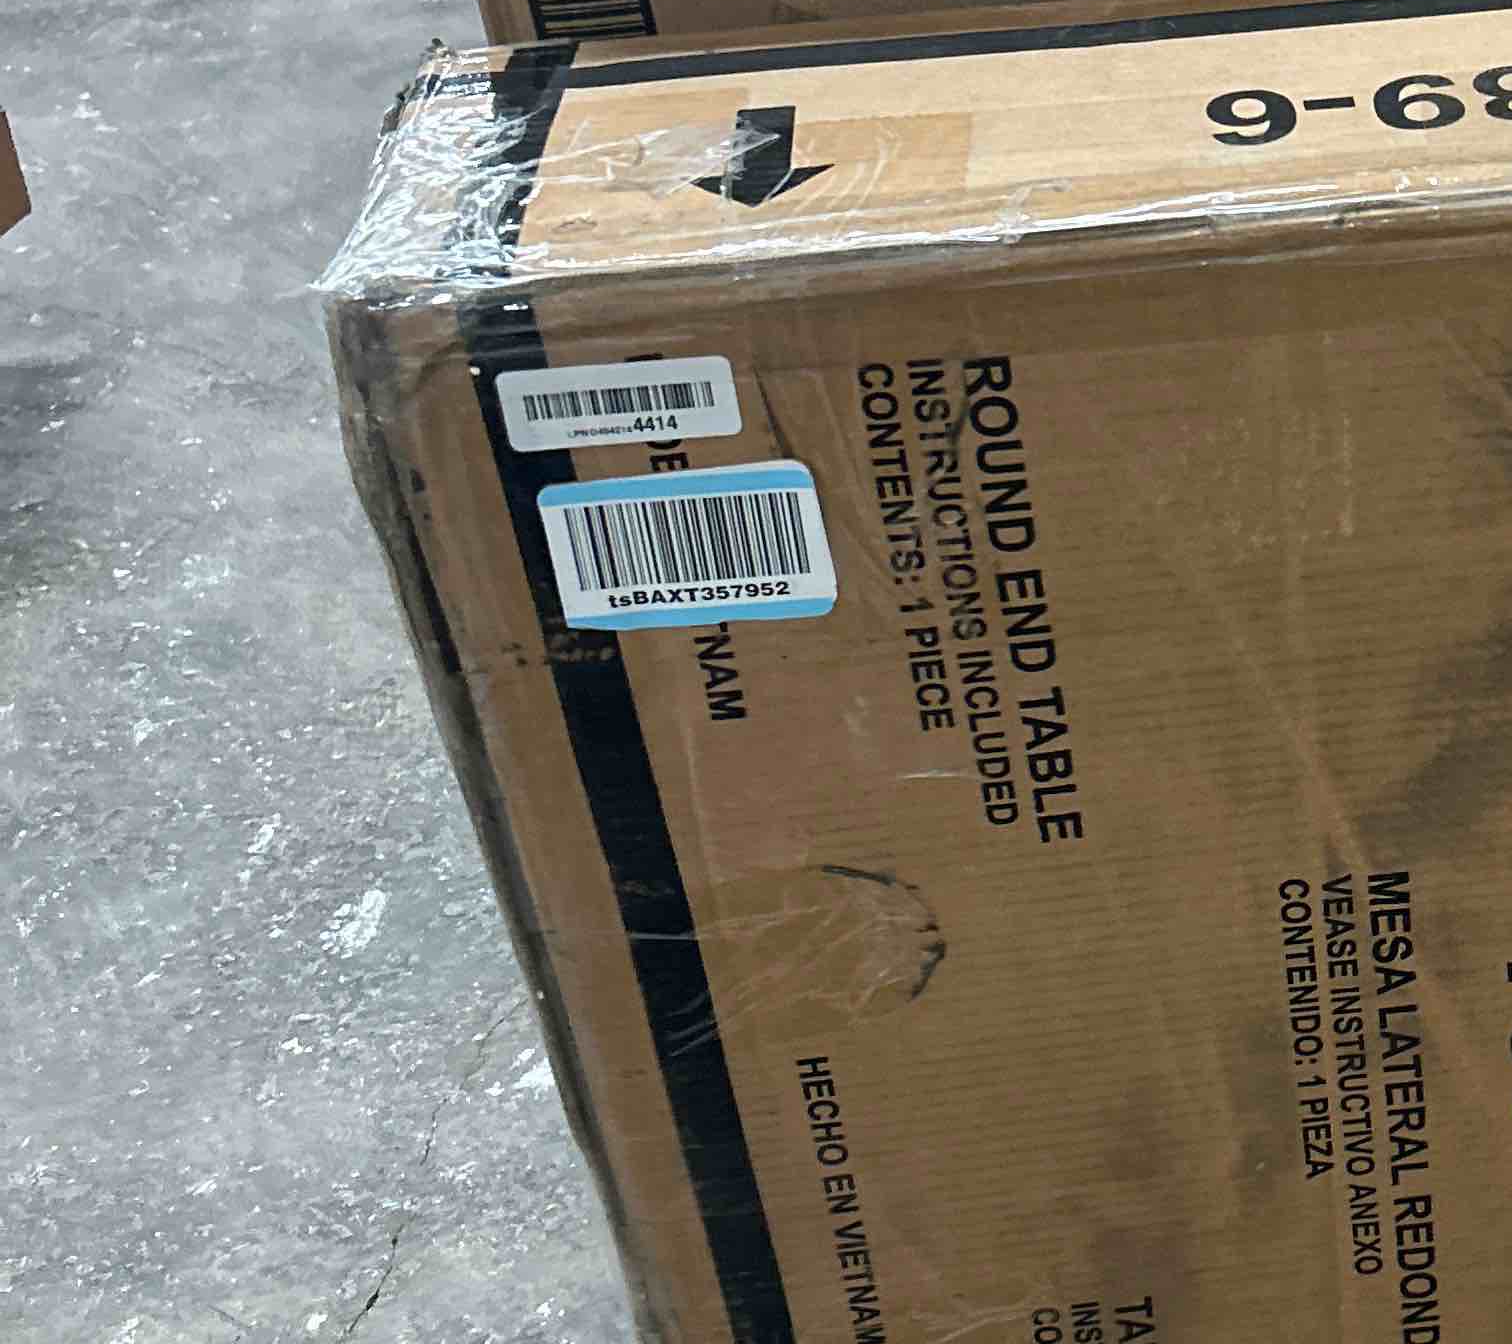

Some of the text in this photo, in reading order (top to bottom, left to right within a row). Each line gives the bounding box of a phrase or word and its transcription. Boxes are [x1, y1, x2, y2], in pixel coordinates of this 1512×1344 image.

[608, 581, 791, 609] tsBAXT357952
[857, 362, 956, 732] CONTENTS: 1 PIECE
[906, 358, 1020, 826] INSTRUCTIONS INCLUDED
[962, 356, 1084, 844] ROUND END TABLE
[1278, 878, 1335, 1179] CONTENIDO: 1 PIEZA
[1367, 871, 1416, 995] MESA
[796, 1056, 849, 1166] HECHO
[822, 1173, 861, 1214] EN
[1321, 874, 1383, 1276] VEASE INSTRUCTIVO ANEXO
[1378, 1004, 1429, 1186] LATERAL
